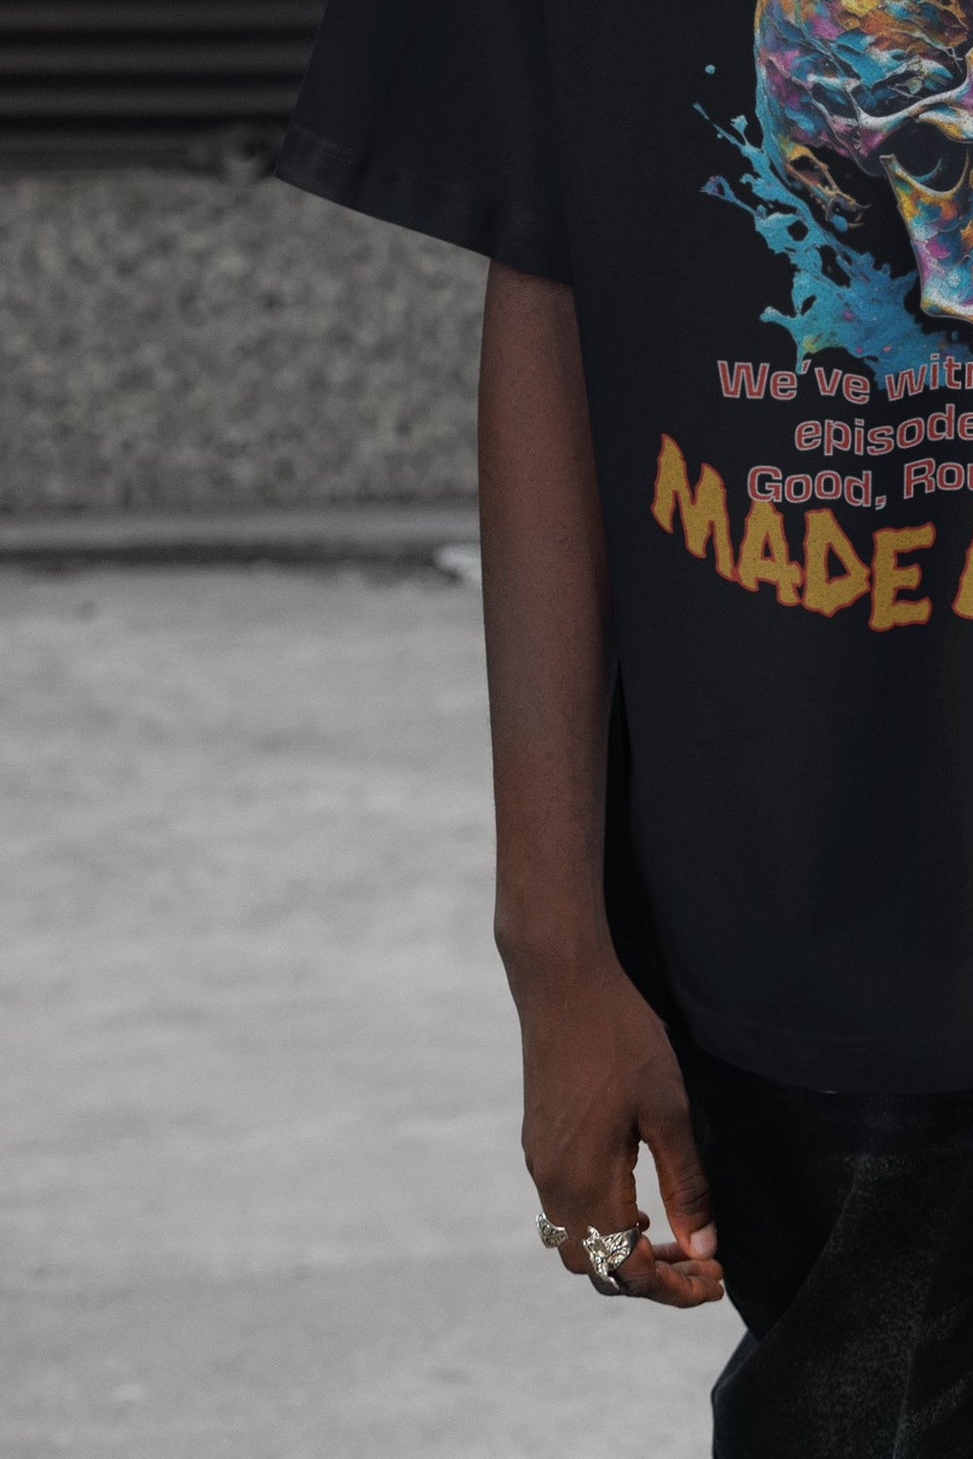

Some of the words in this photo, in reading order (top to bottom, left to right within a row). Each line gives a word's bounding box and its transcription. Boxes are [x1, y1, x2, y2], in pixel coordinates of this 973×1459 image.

[717, 359, 870, 405] We've
[747, 465, 887, 511] Good,
[651, 433, 935, 632] MADE
